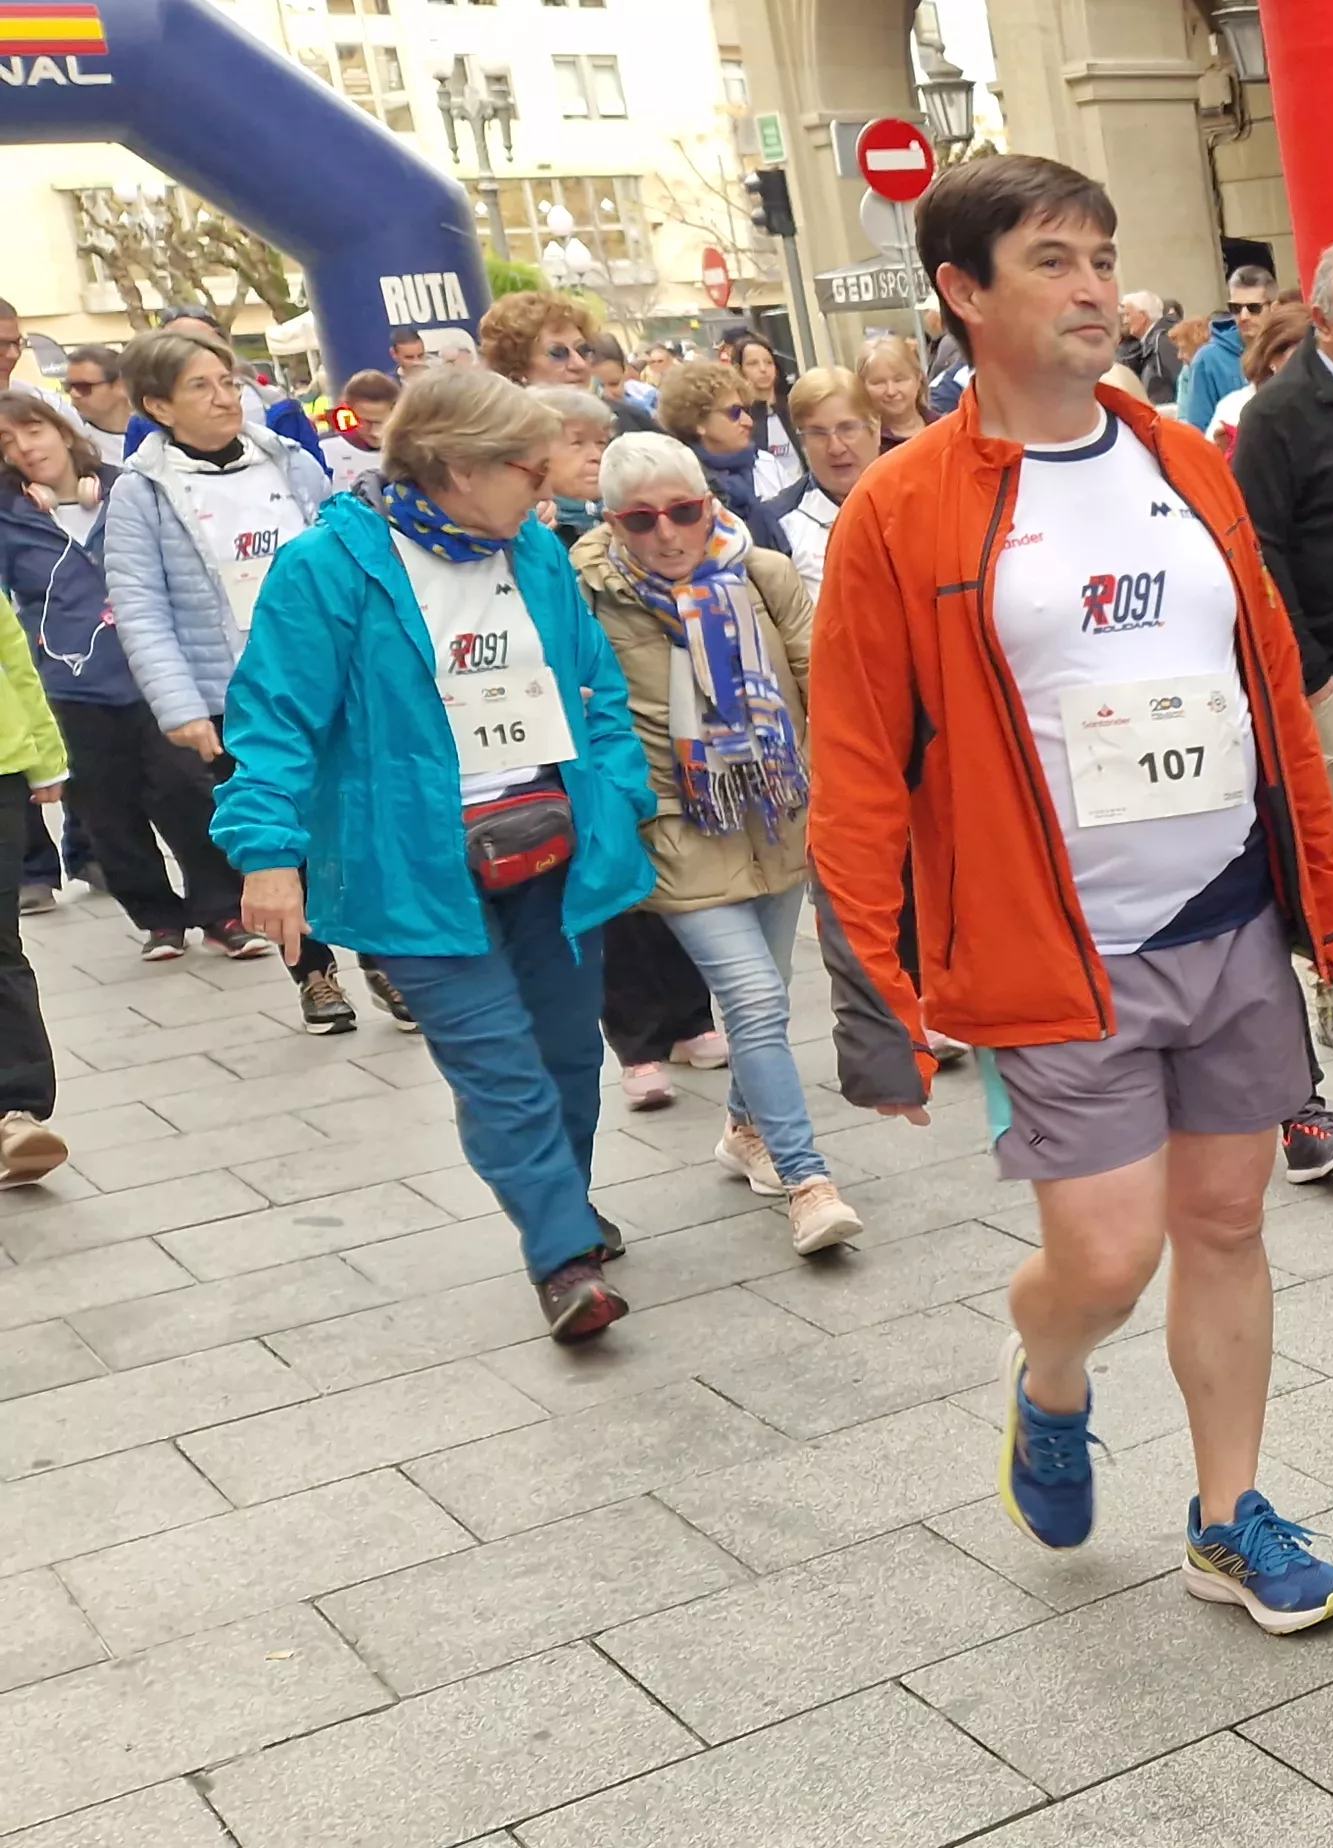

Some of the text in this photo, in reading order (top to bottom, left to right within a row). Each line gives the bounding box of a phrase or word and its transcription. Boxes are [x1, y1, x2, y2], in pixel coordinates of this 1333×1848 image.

[380, 272, 471, 325] RUTA
[832, 276, 874, 303] GED
[473, 720, 526, 748] 116
[1137, 745, 1205, 784] 107
